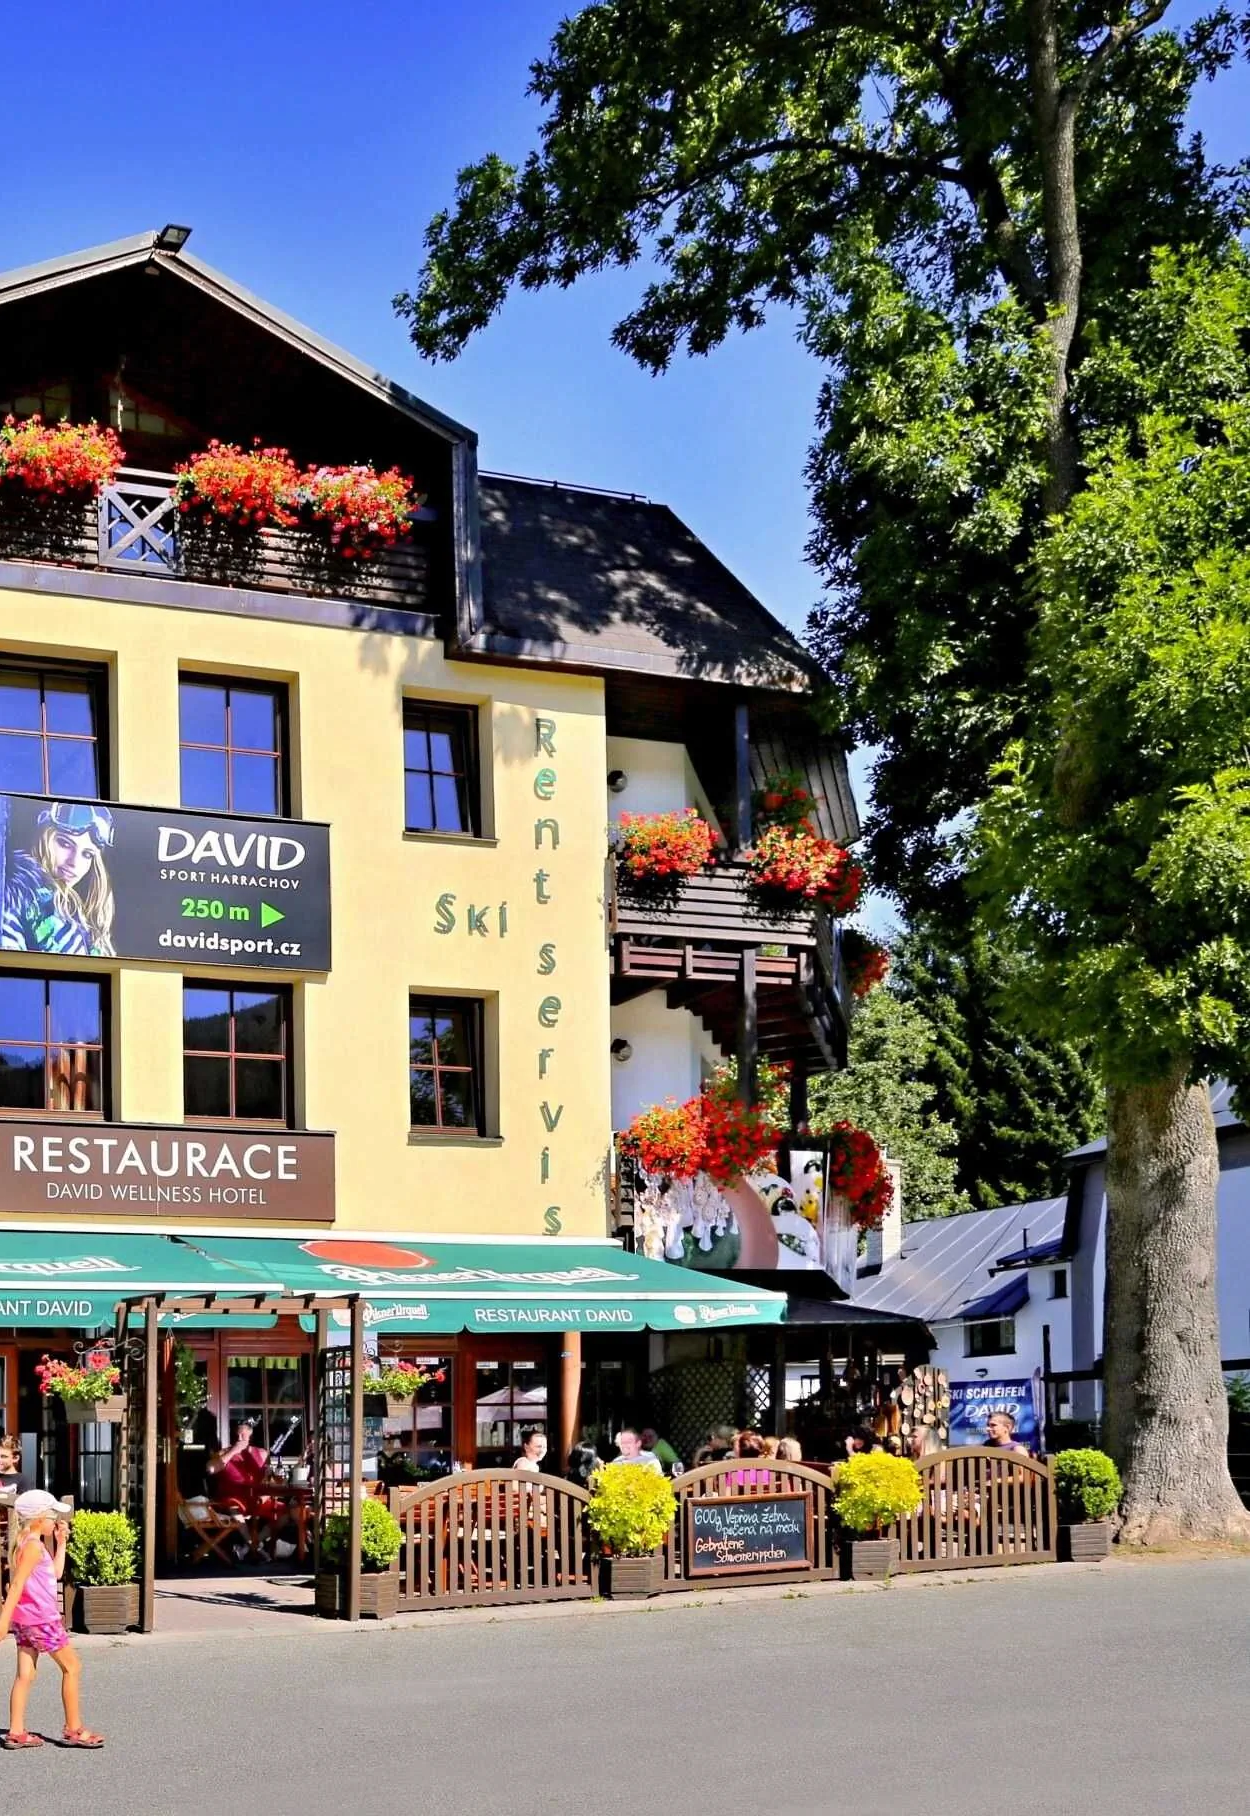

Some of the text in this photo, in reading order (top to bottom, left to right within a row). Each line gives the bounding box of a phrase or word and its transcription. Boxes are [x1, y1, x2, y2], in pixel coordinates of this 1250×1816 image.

[533, 717, 559, 904] Rent
[157, 826, 305, 871] DAVID
[160, 868, 299, 890] SPORT HARRACHOV
[181, 898, 250, 921] 250 m
[434, 893, 508, 937] Ski
[158, 929, 301, 956] davidsport.cz
[13, 1135, 298, 1180] RESTAURACE
[47, 1182, 267, 1205] DAVID WELLNESS HOTEL
[36, 1301, 91, 1316] DAVID
[362, 1302, 431, 1327] Pilsner Urquell
[475, 1308, 633, 1322] RESTAURANT DAVID
[965, 1386, 1026, 1400] SCHLEIFEN
